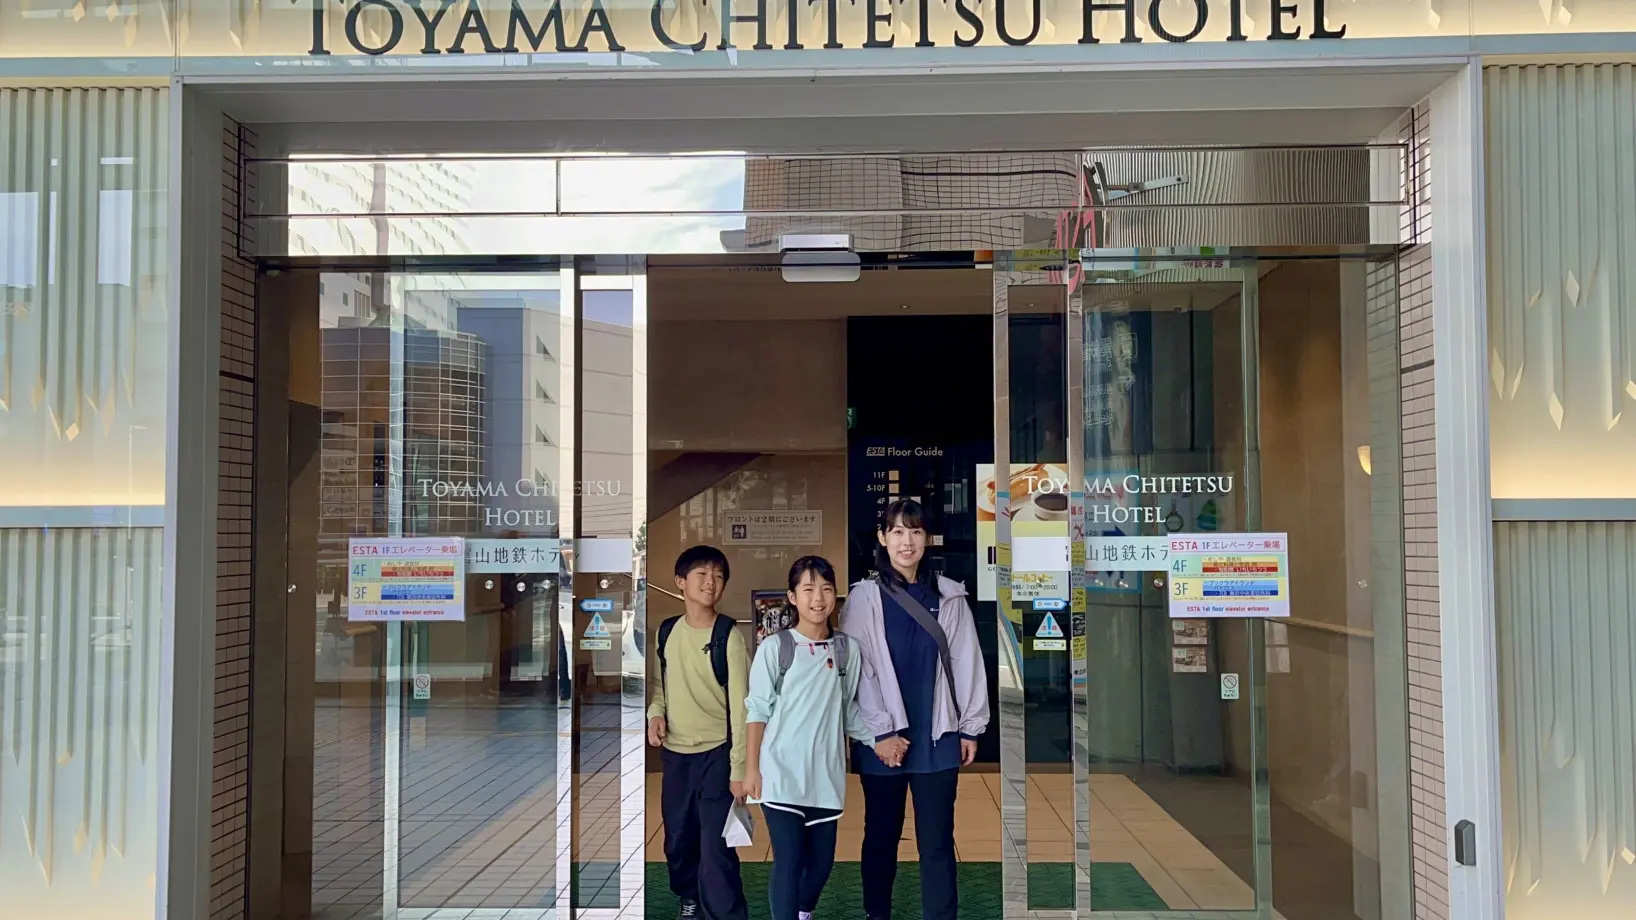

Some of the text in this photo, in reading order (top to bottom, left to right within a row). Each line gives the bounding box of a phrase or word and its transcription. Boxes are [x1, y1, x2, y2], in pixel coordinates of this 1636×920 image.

[290, 0, 1346, 55] TOYAMA CHITETSU HOTEL
[888, 447, 912, 456] Floor
[914, 447, 943, 456] Guide
[418, 478, 621, 497] TOYAMA CHIETSU
[1122, 475, 1233, 494] CHITETSU
[484, 507, 556, 526] HOTEL
[1092, 505, 1166, 523] HOTEL
[352, 546, 378, 555] ESTA
[1171, 542, 1198, 550] ESTA
[353, 564, 367, 577] 4F
[1173, 560, 1187, 573] 4F
[354, 587, 367, 600] 3F
[1174, 582, 1188, 596] 3F
